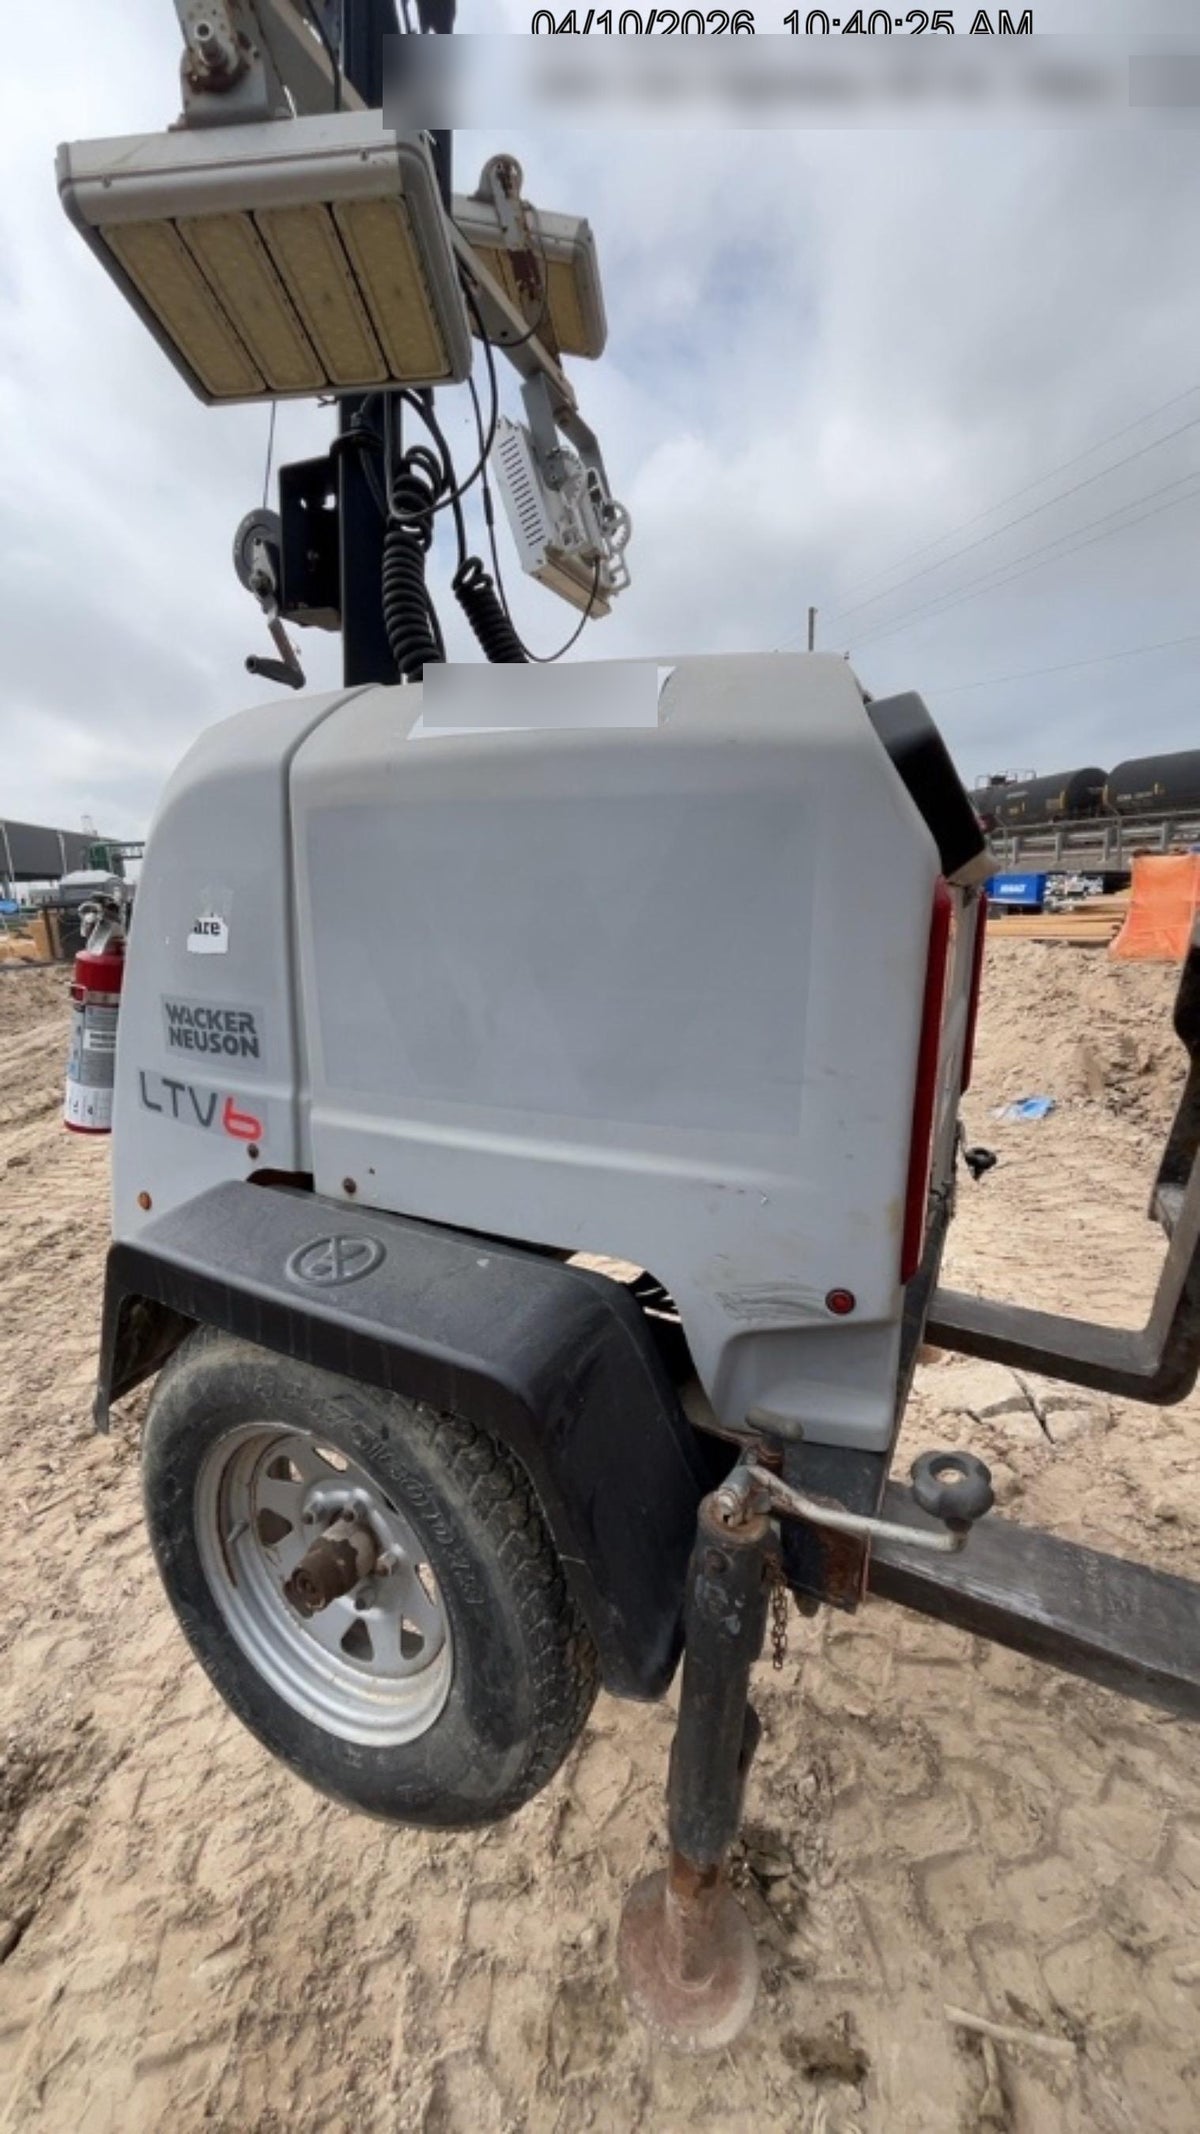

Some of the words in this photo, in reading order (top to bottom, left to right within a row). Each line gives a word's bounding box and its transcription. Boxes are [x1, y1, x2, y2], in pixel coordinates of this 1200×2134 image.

[165, 1003, 257, 1034] WACKER
[167, 1026, 260, 1058] NEUSON
[139, 1071, 263, 1142] LTV6
